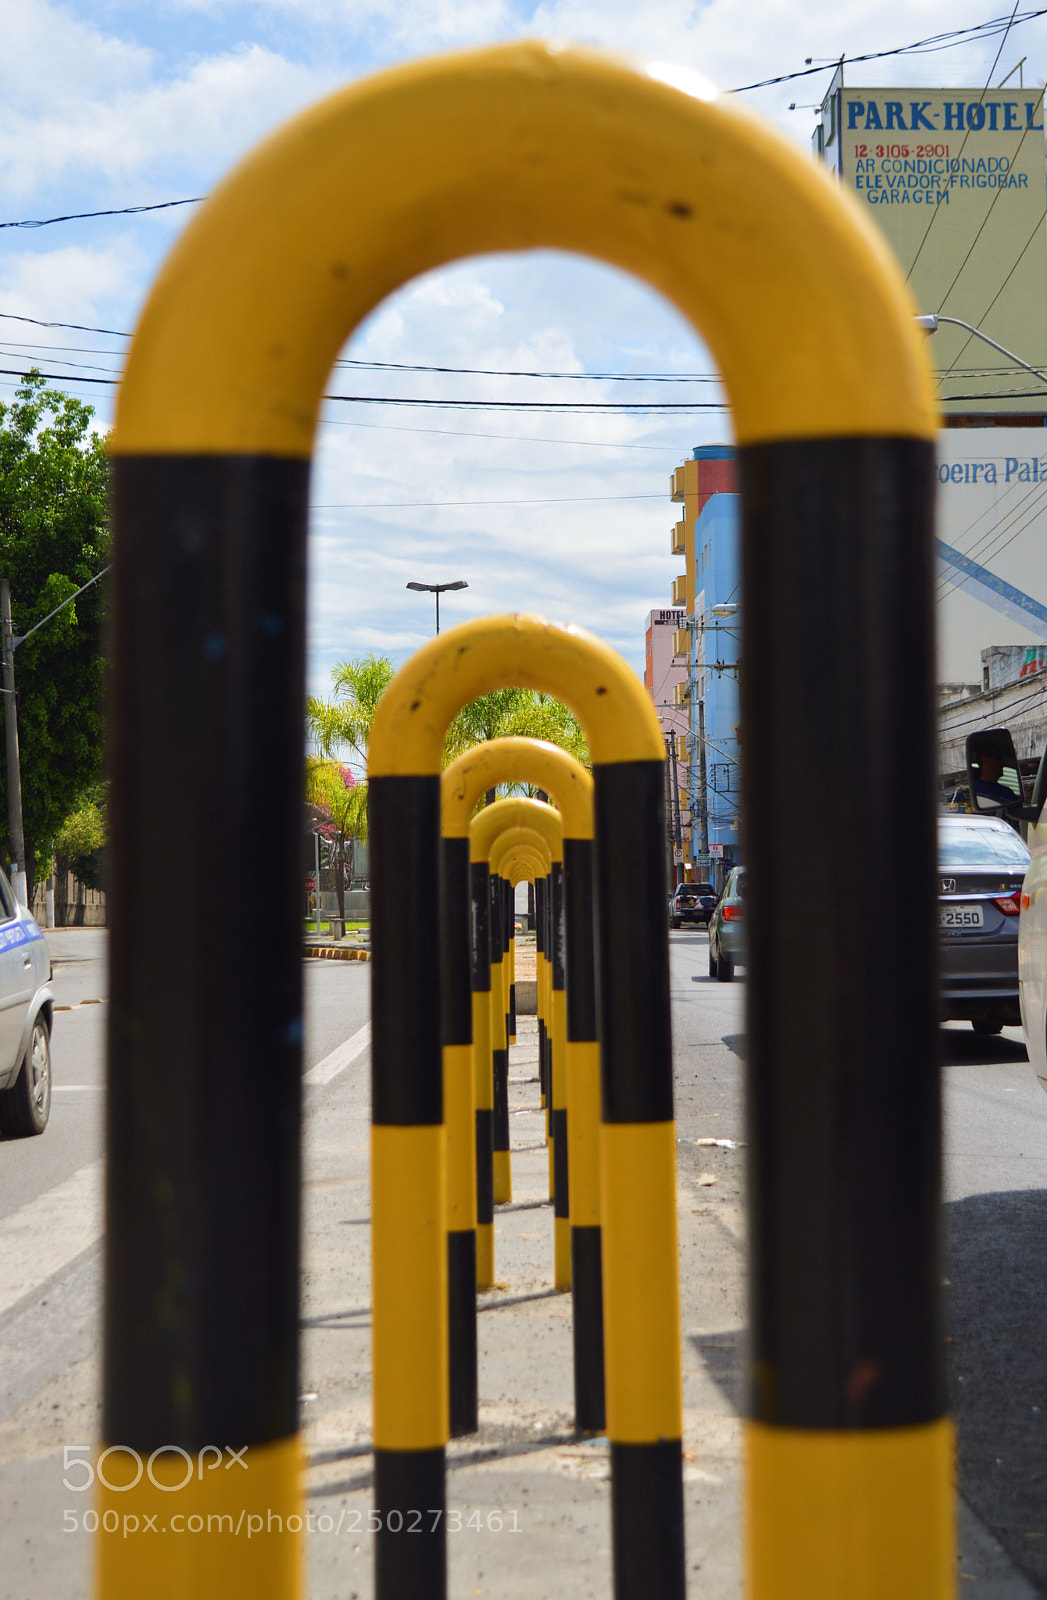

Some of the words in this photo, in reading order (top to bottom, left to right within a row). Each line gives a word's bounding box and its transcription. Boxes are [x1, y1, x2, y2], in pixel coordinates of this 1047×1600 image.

[847, 101, 1044, 131] PARK-HOTEL
[855, 158, 875, 173] AR
[881, 157, 1010, 174] CONDICIONADO
[867, 189, 950, 205] GARAGEM
[937, 463, 998, 484] oeira
